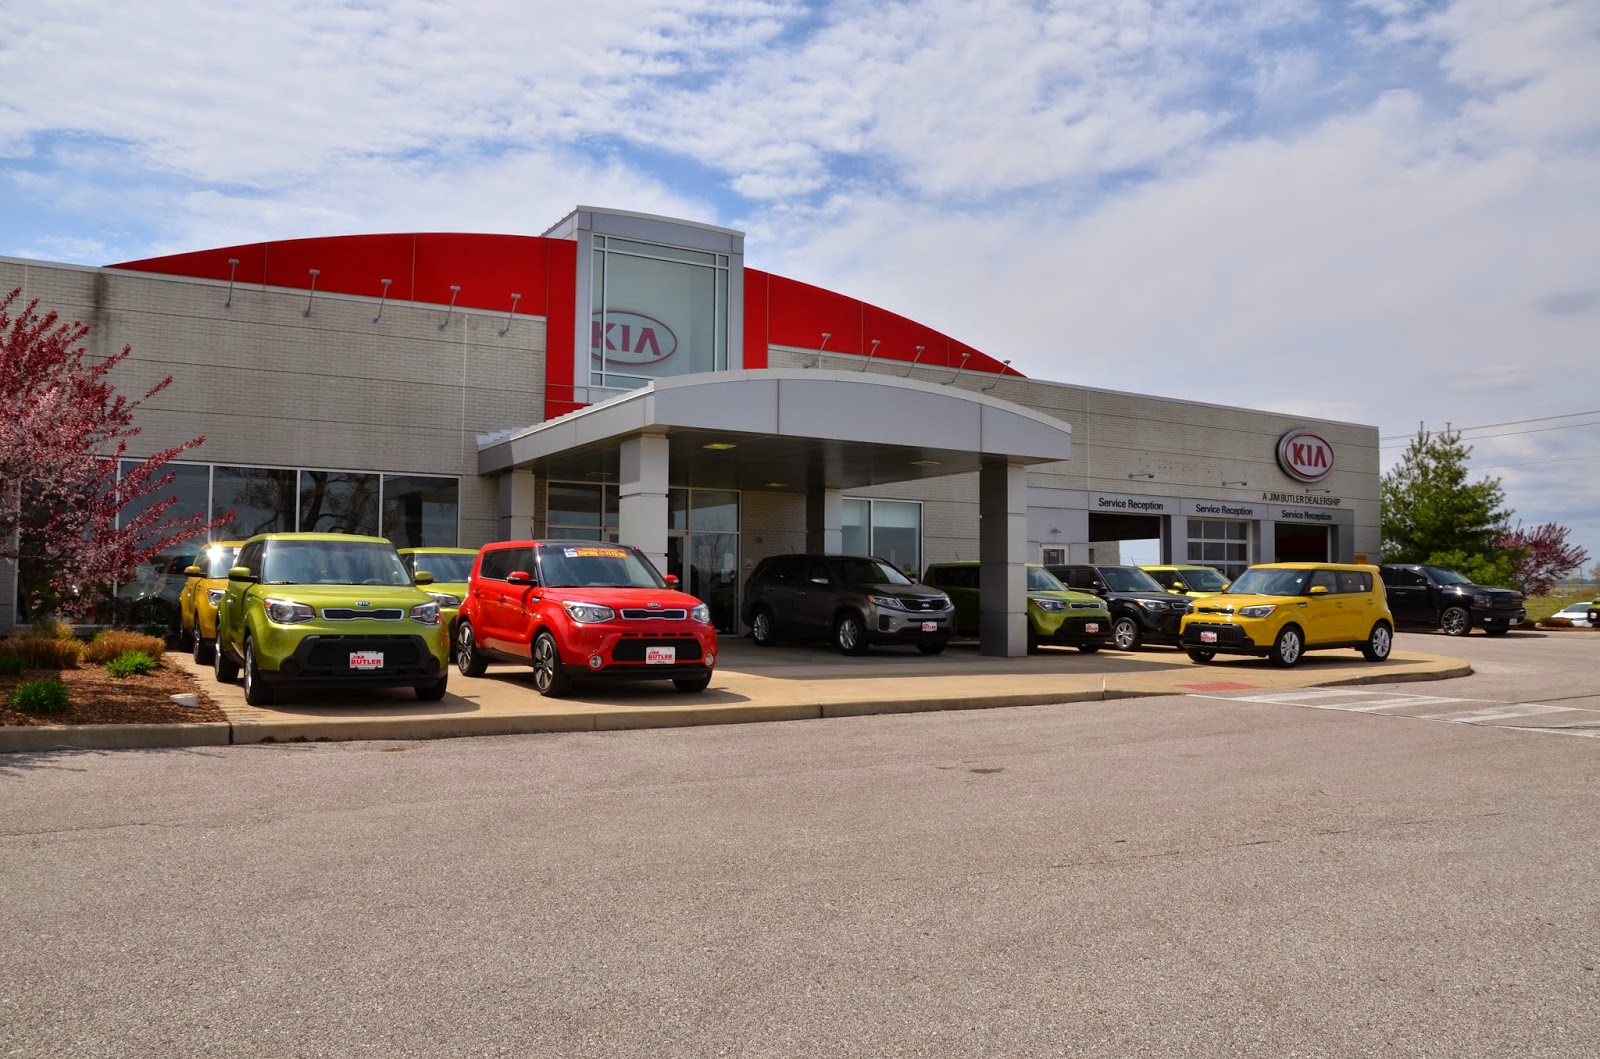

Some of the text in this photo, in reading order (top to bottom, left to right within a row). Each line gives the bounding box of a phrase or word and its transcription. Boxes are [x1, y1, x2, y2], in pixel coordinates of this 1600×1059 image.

[591, 320, 662, 356] KIA
[1292, 443, 1327, 468] KIA
[1098, 497, 1164, 511] Service Reception
[1262, 493, 1341, 506] A JIM BUTLER DEALERSHIP
[1195, 503, 1254, 517] Service Reception
[1281, 509, 1333, 522] Service Reception
